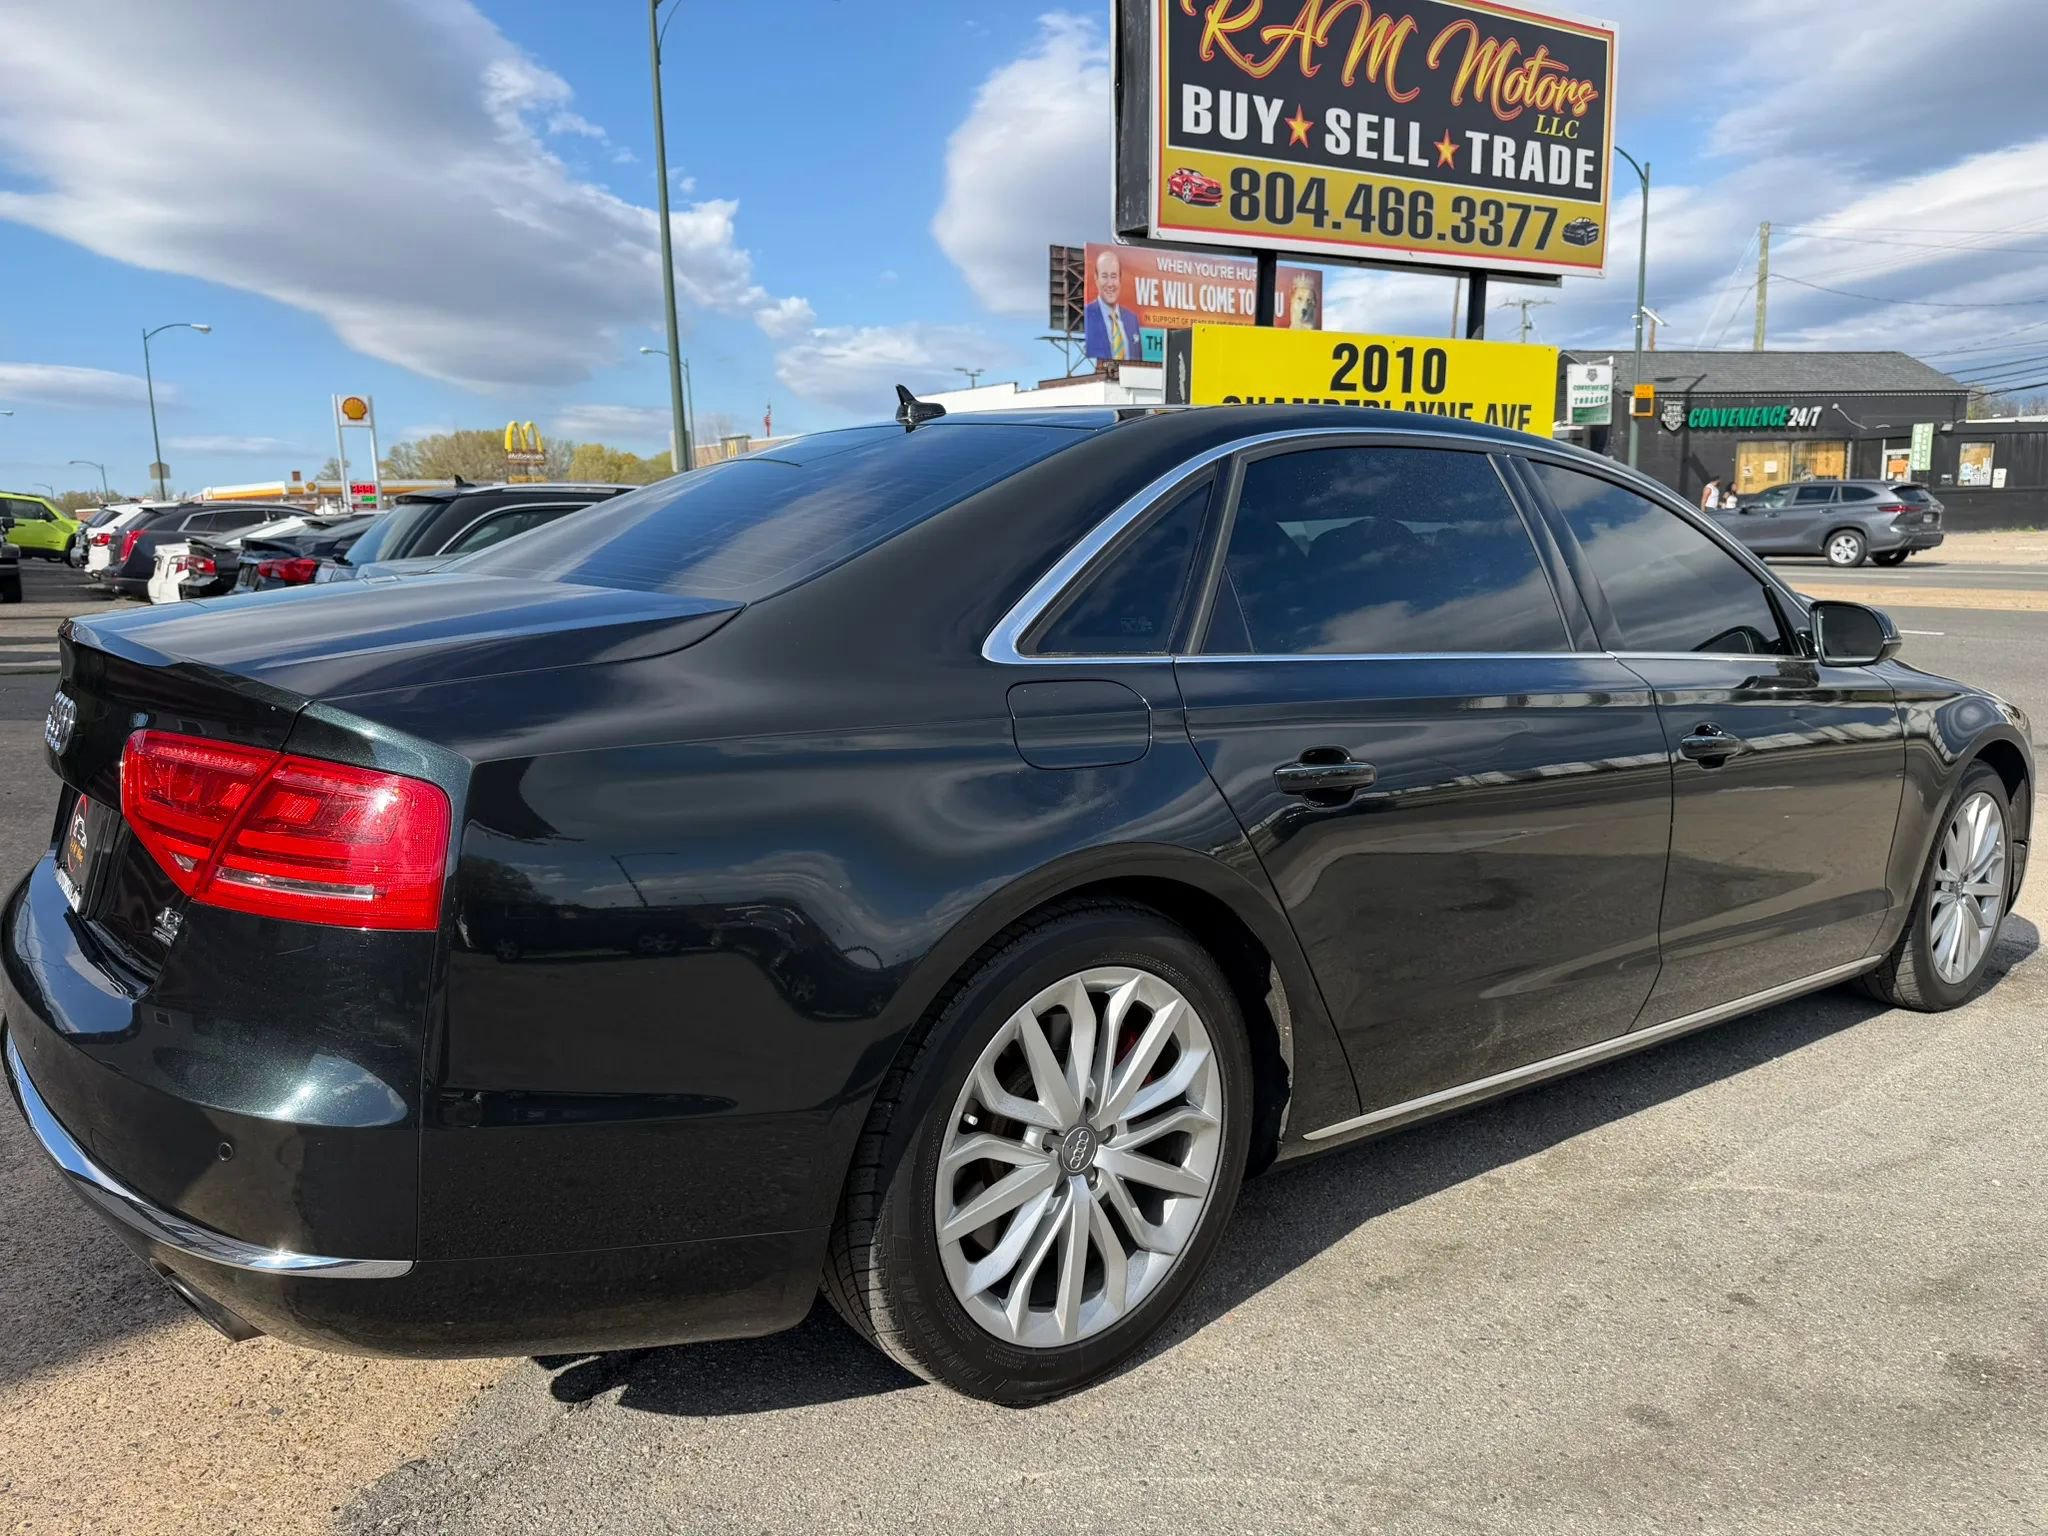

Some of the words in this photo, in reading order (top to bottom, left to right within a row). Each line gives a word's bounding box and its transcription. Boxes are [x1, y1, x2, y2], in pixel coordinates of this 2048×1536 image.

[1181, 0, 1420, 103] RAM
[1426, 18, 1599, 122] Motors
[1182, 83, 1285, 144] BUY
[1324, 107, 1430, 167] SELL
[1465, 130, 1595, 190] TRADE
[1534, 114, 1580, 139] LLC
[1229, 167, 1559, 251] 804.466.3377
[1156, 257, 1192, 274] WHEN
[1195, 263, 1234, 279] YOU'RE
[1236, 267, 1257, 281] HUR
[1135, 277, 1160, 306] WE
[1162, 279, 1196, 311] WILL
[1199, 283, 1235, 315] COME
[1238, 288, 1257, 316] TO
[1152, 315, 1180, 325] SUPPORT
[1330, 342, 1447, 395] 2010
[1687, 405, 1789, 428] CONVENIENCE
[1787, 405, 1823, 427] 24/7
